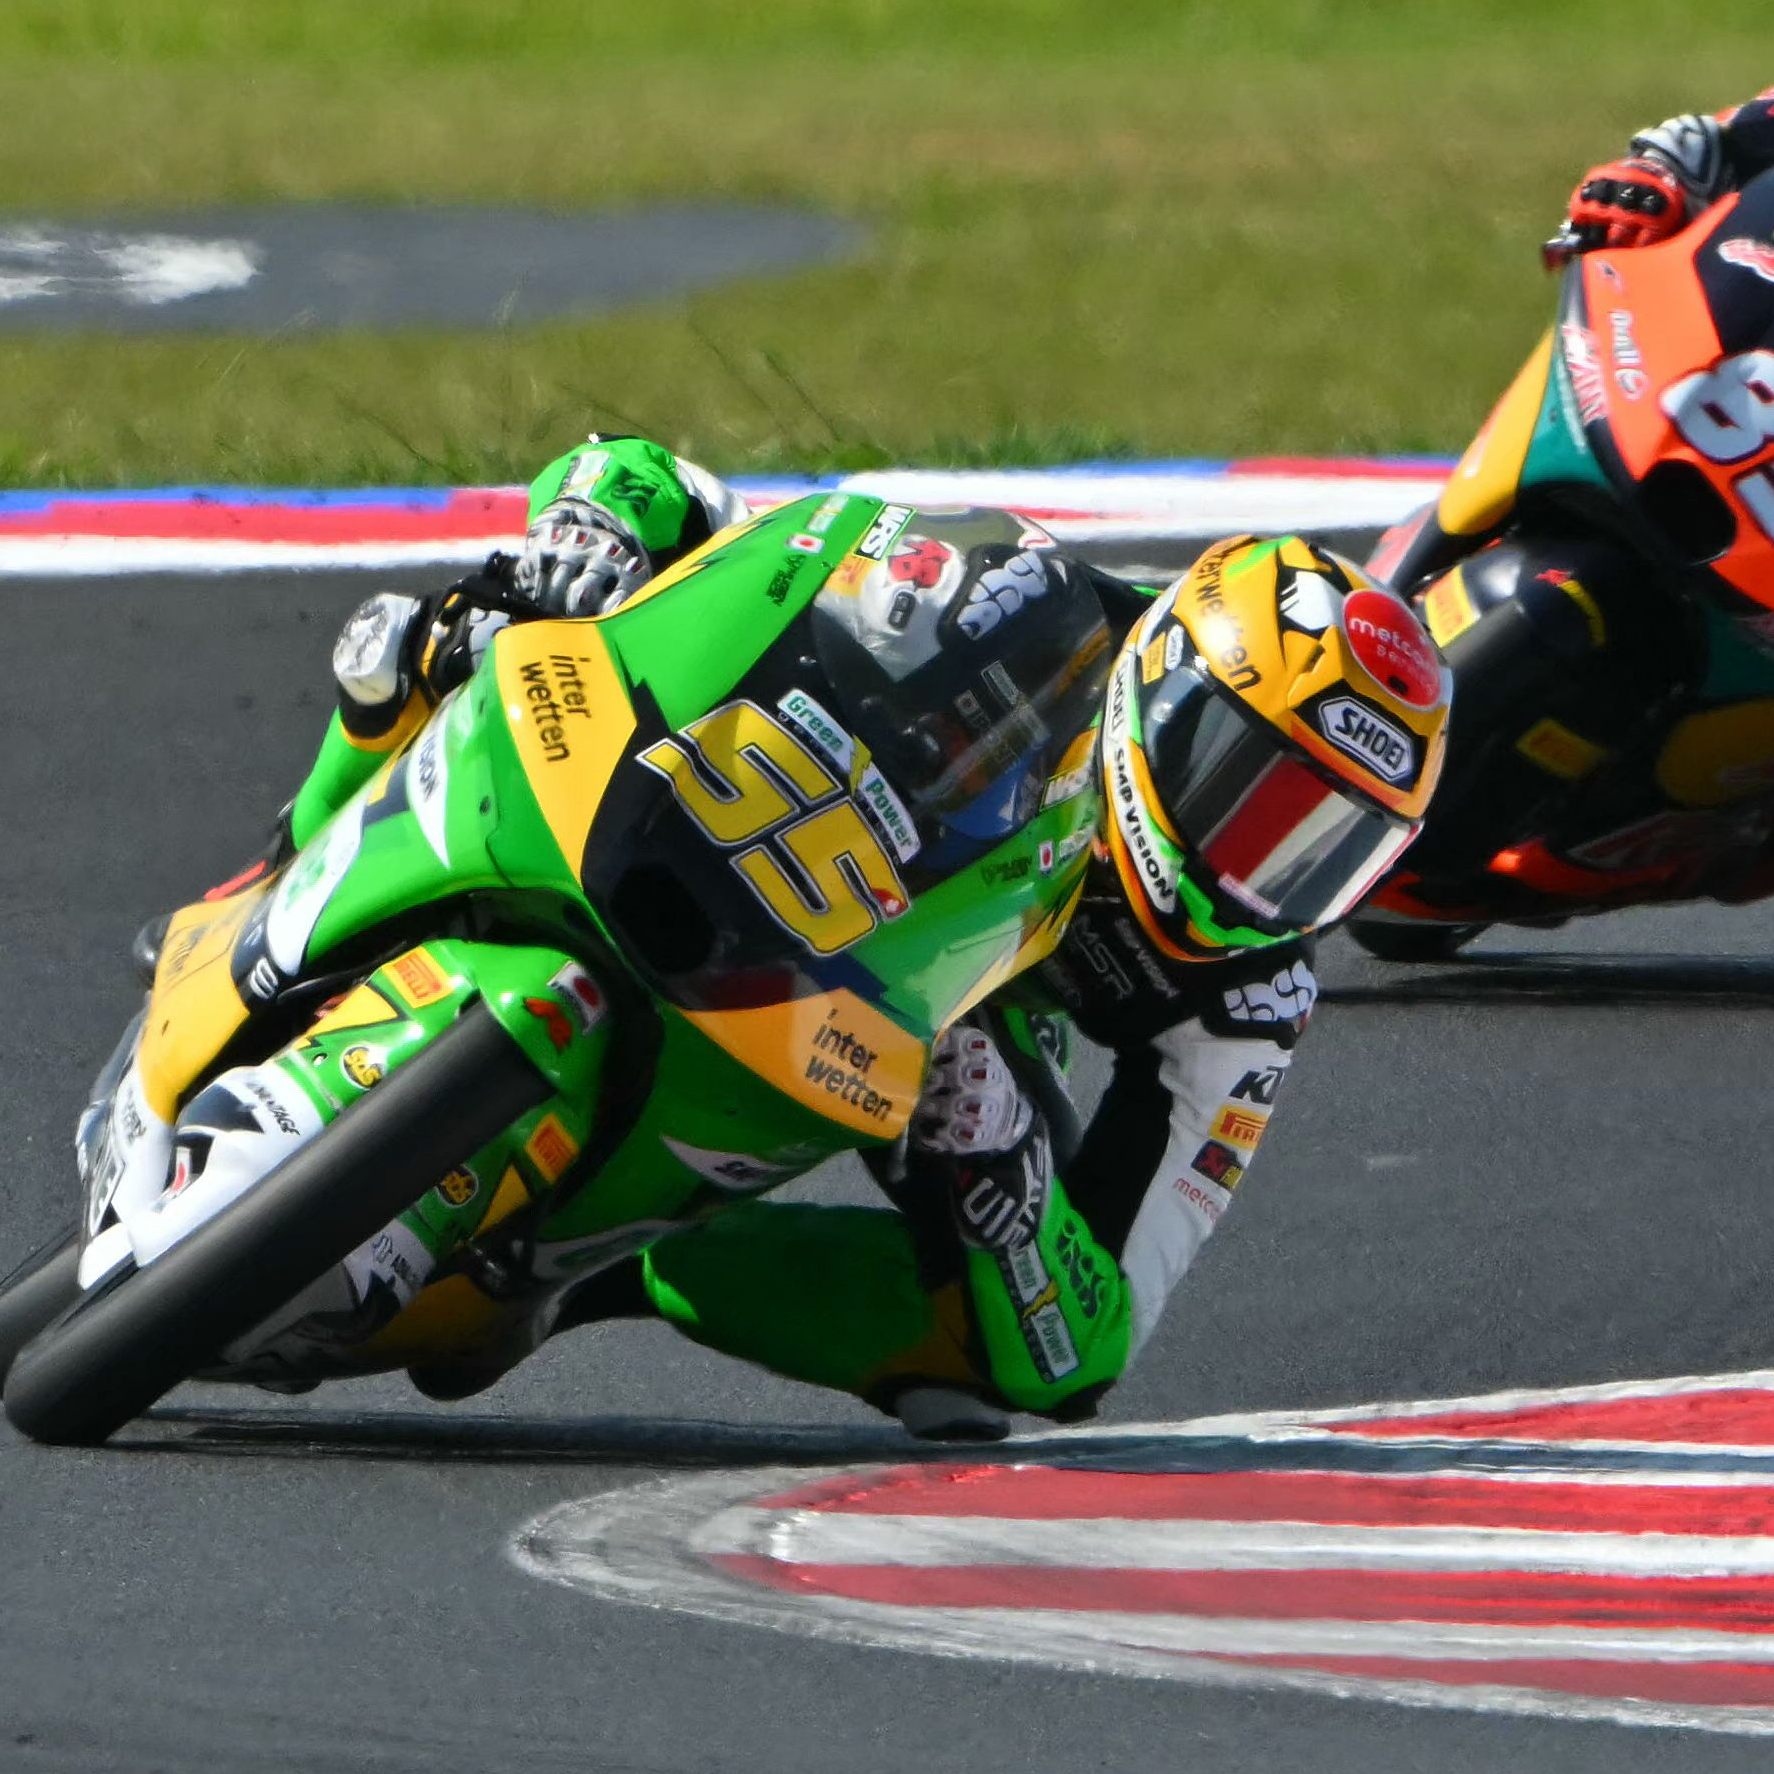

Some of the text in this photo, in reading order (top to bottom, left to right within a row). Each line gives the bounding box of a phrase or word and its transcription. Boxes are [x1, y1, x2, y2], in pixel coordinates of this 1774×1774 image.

[520, 661, 571, 763] wetten
[549, 655, 591, 718] inter
[786, 694, 913, 850] Green Power
[634, 698, 911, 957] 55
[1125, 807, 1174, 899] VISION
[812, 1008, 878, 1074] inter
[805, 1055, 893, 1122] wetten
